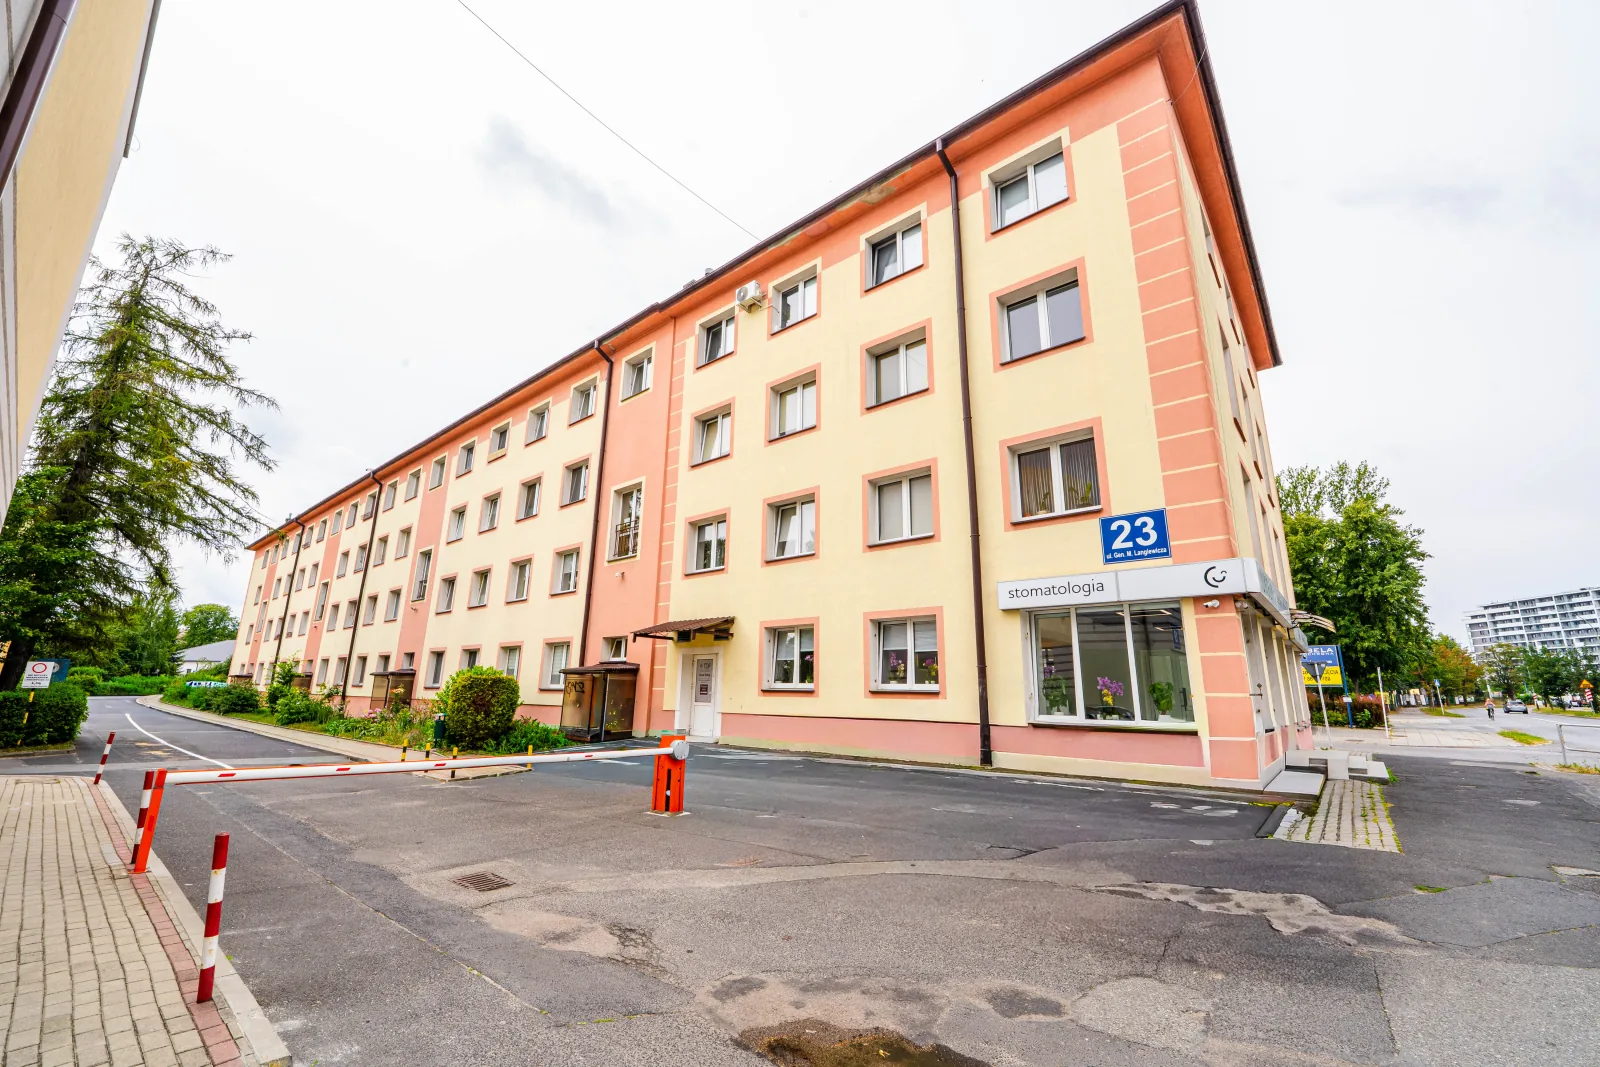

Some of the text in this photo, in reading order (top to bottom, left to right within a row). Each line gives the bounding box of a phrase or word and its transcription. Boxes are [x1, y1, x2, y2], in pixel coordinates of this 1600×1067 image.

[1110, 516, 1158, 550] 23
[1134, 547, 1168, 557] Langiewicza
[1008, 579, 1104, 598] stomatologia
